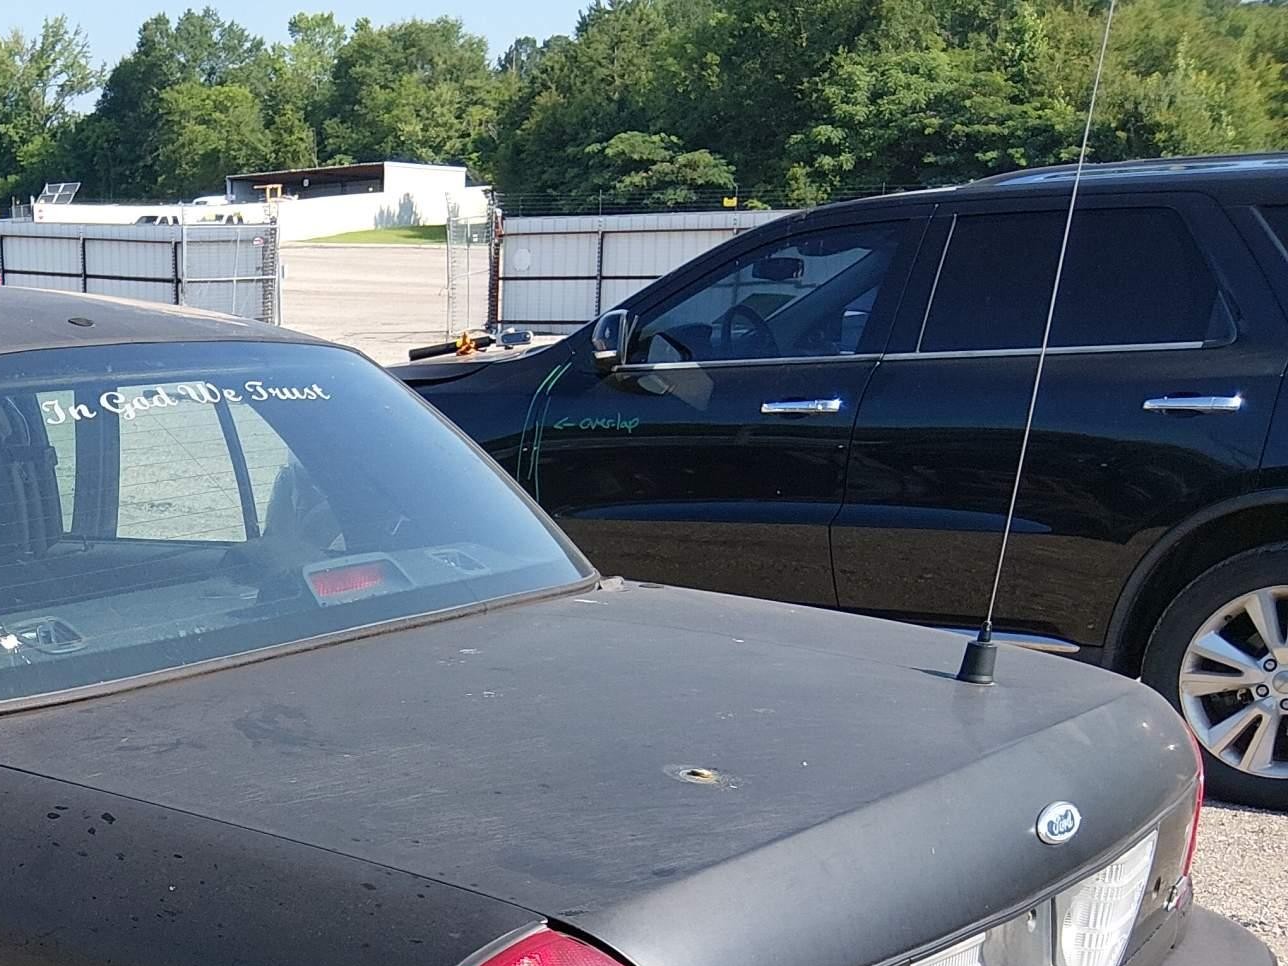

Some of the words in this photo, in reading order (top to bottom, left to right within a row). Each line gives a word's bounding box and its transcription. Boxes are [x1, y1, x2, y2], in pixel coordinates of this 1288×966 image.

[41, 398, 97, 425] In
[99, 389, 178, 421] God
[177, 382, 242, 404] We
[244, 380, 331, 401] Trust
[579, 412, 640, 434] overlap
